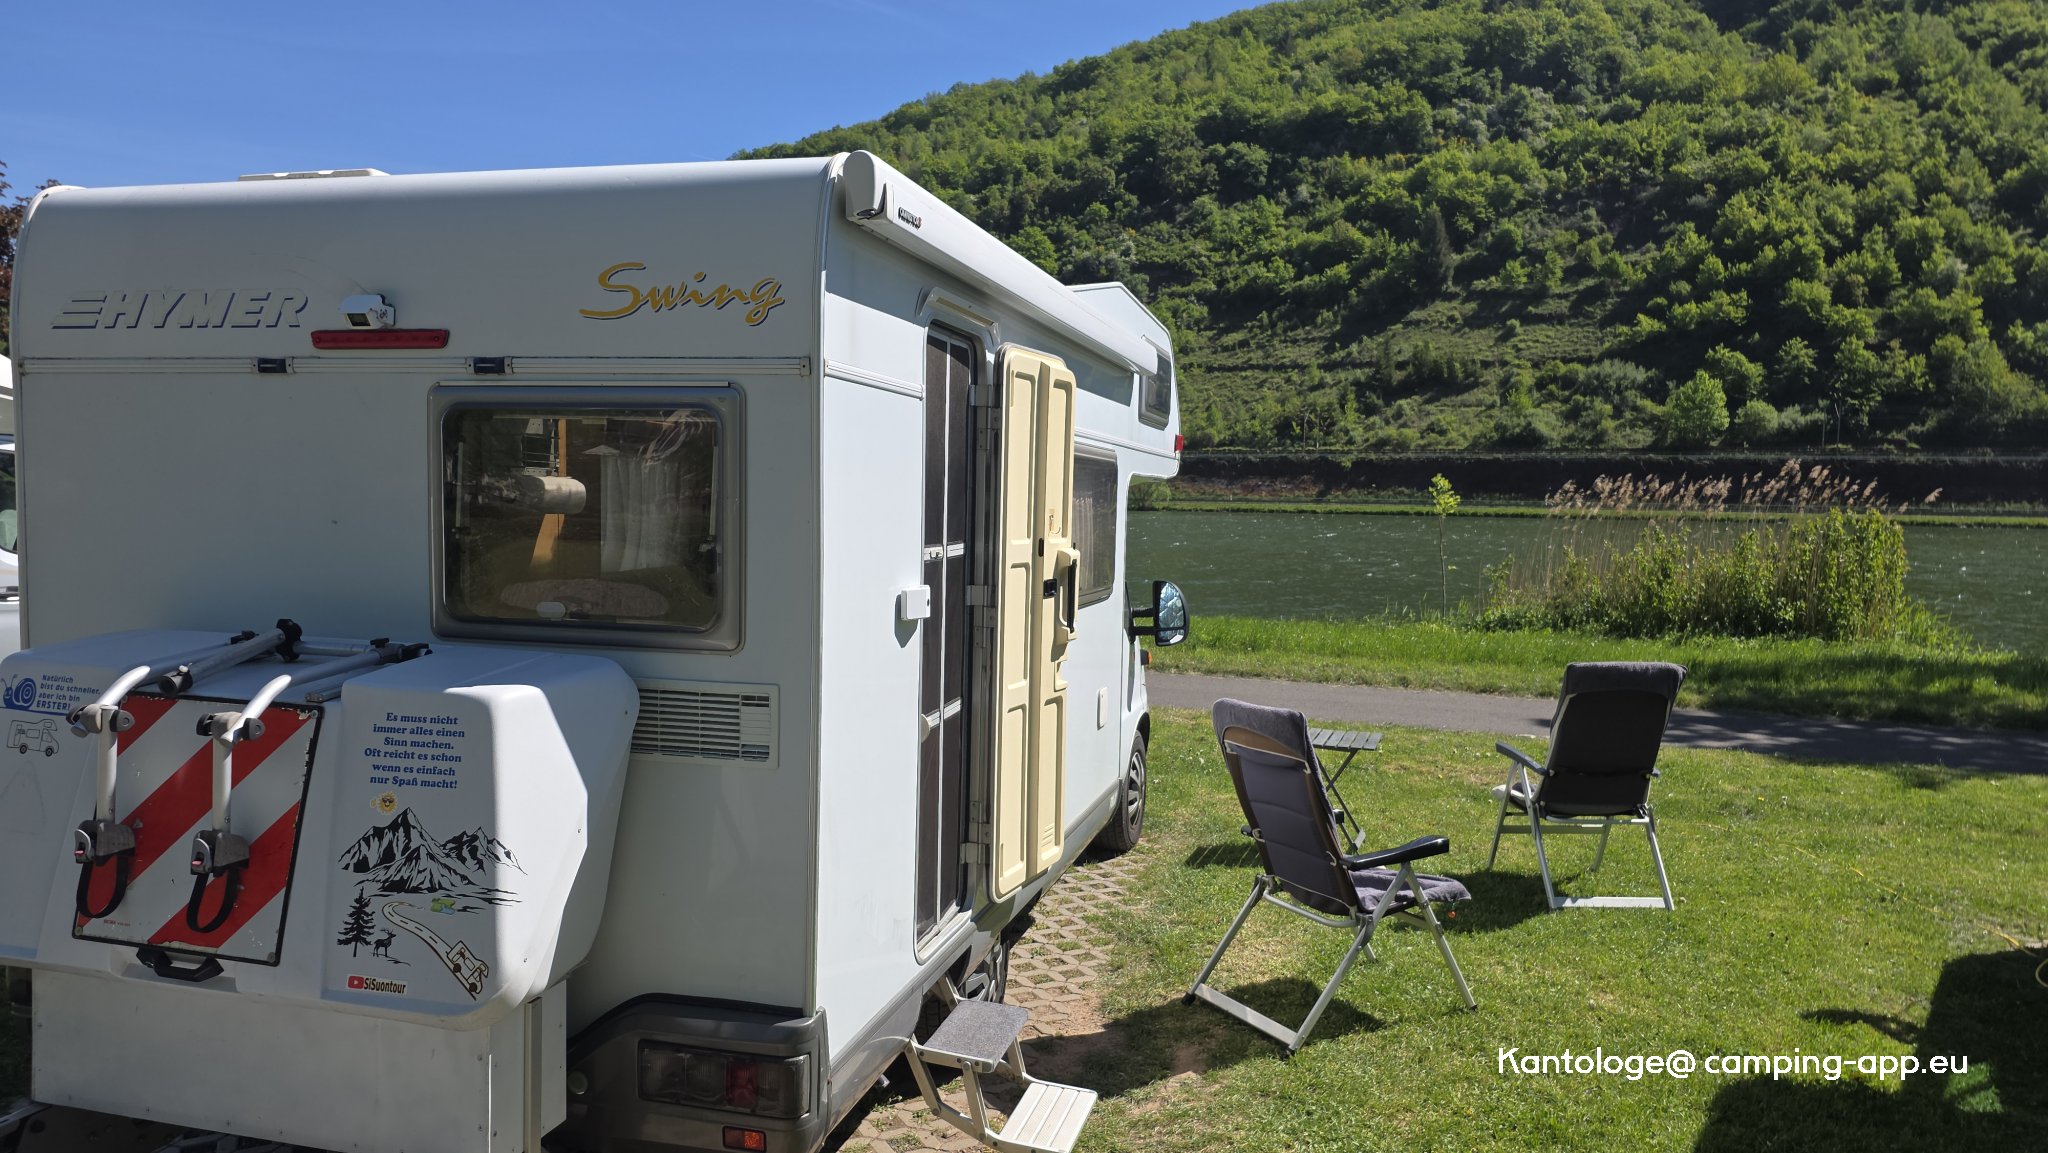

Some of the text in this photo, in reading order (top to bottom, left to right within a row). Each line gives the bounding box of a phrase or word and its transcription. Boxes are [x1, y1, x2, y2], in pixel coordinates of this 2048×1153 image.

[578, 262, 786, 327] Swing
[52, 288, 309, 329] HYMER
[42, 674, 74, 684] Natürlich
[40, 682, 54, 690] bist
[66, 685, 101, 695] schneller,
[38, 692, 80, 702] aber ich bin
[36, 700, 71, 711] ERSTER!
[386, 712, 459, 725] Es muss nicht
[373, 724, 465, 738] immer alles einen
[383, 736, 455, 750] Sinn machen.
[364, 747, 462, 763] Oft reicht es schon
[372, 763, 456, 776] wenn es einfach
[369, 775, 458, 789] nur Spaß macht!
[364, 977, 407, 994] SiSuontour
